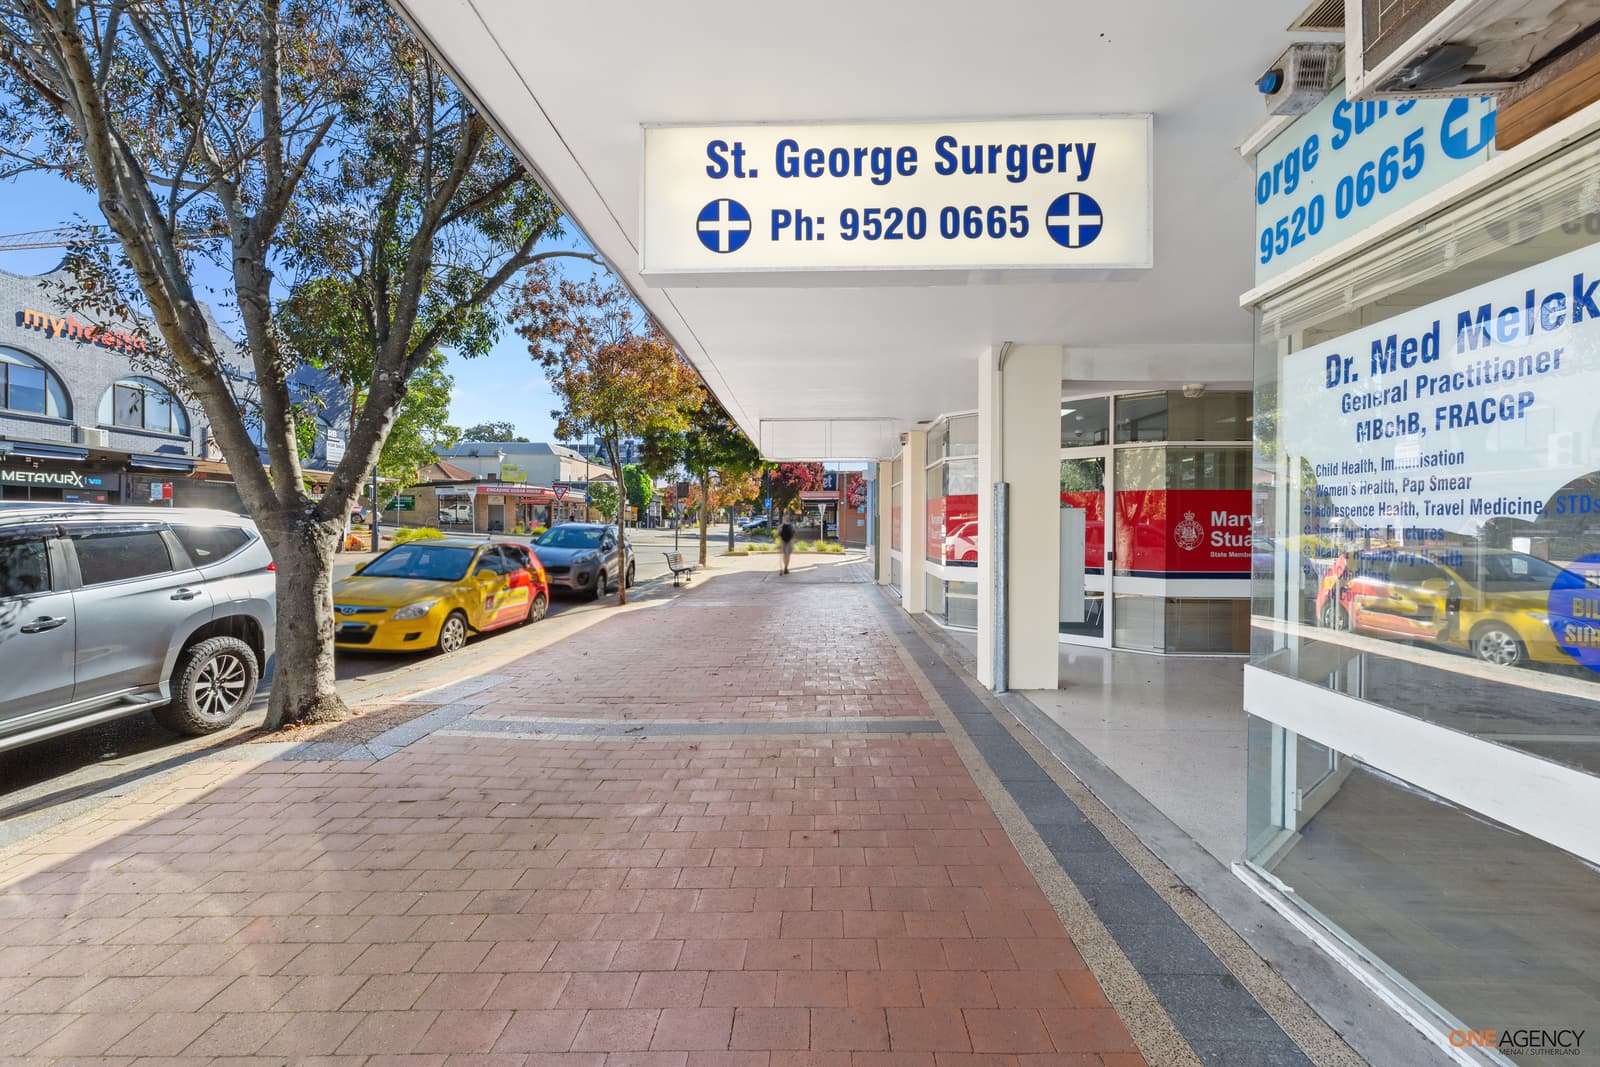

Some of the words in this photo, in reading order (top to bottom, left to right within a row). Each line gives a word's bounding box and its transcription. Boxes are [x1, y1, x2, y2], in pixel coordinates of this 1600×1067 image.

[706, 139, 758, 179] St.
[775, 138, 918, 185] George
[934, 135, 1097, 183] Surgery
[1257, 134, 1319, 205] orge
[1260, 194, 1325, 265] 9520
[1335, 127, 1425, 220] 0665
[770, 208, 825, 241] Ph:
[839, 206, 928, 241] 9520
[939, 204, 1030, 240] 0665
[1325, 353, 1359, 389] Dr.
[1370, 319, 1441, 378] Med
[1456, 272, 1600, 355] Melek
[1341, 379, 1408, 415] General
[1415, 347, 1564, 399] Practitioner
[1356, 411, 1427, 444] MBchB,
[1435, 391, 1536, 432] FRACGP
[1, 470, 84, 488] METAVURX
[1315, 461, 1339, 478] Child
[1341, 458, 1377, 475] Health,
[1360, 478, 1398, 496] Health,
[1402, 477, 1425, 495] Pap
[1429, 475, 1472, 491] Smear
[1210, 510, 1253, 530] Mary
[1315, 503, 1375, 518] Adolescence
[1378, 500, 1419, 518] Health,
[1423, 499, 1464, 516] Travel
[1469, 497, 1549, 518] Medicine,
